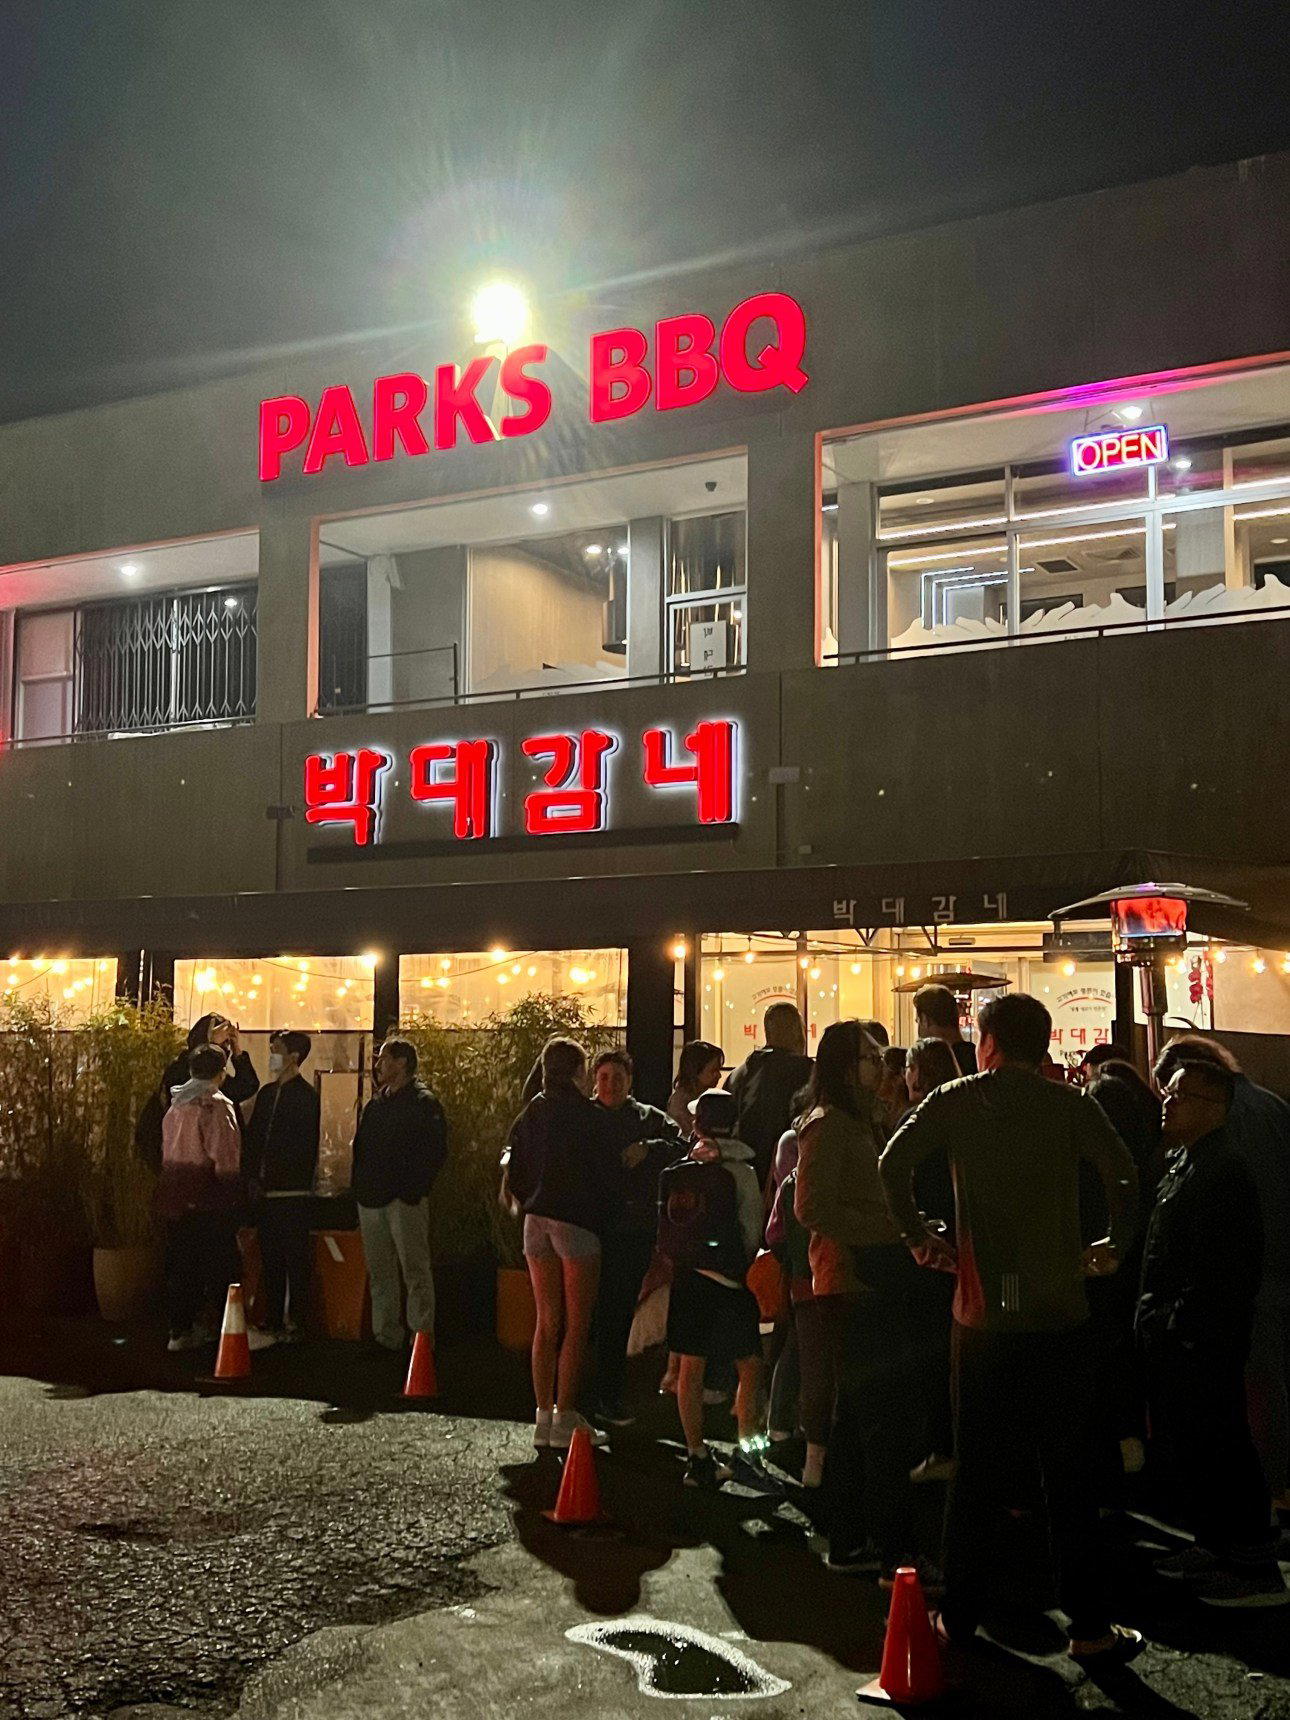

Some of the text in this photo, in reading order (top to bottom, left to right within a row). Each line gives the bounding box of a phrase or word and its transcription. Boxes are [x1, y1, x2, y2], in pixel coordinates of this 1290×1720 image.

[258, 292, 810, 481] PARKS BBQ
[1078, 430, 1162, 470] OPEN
